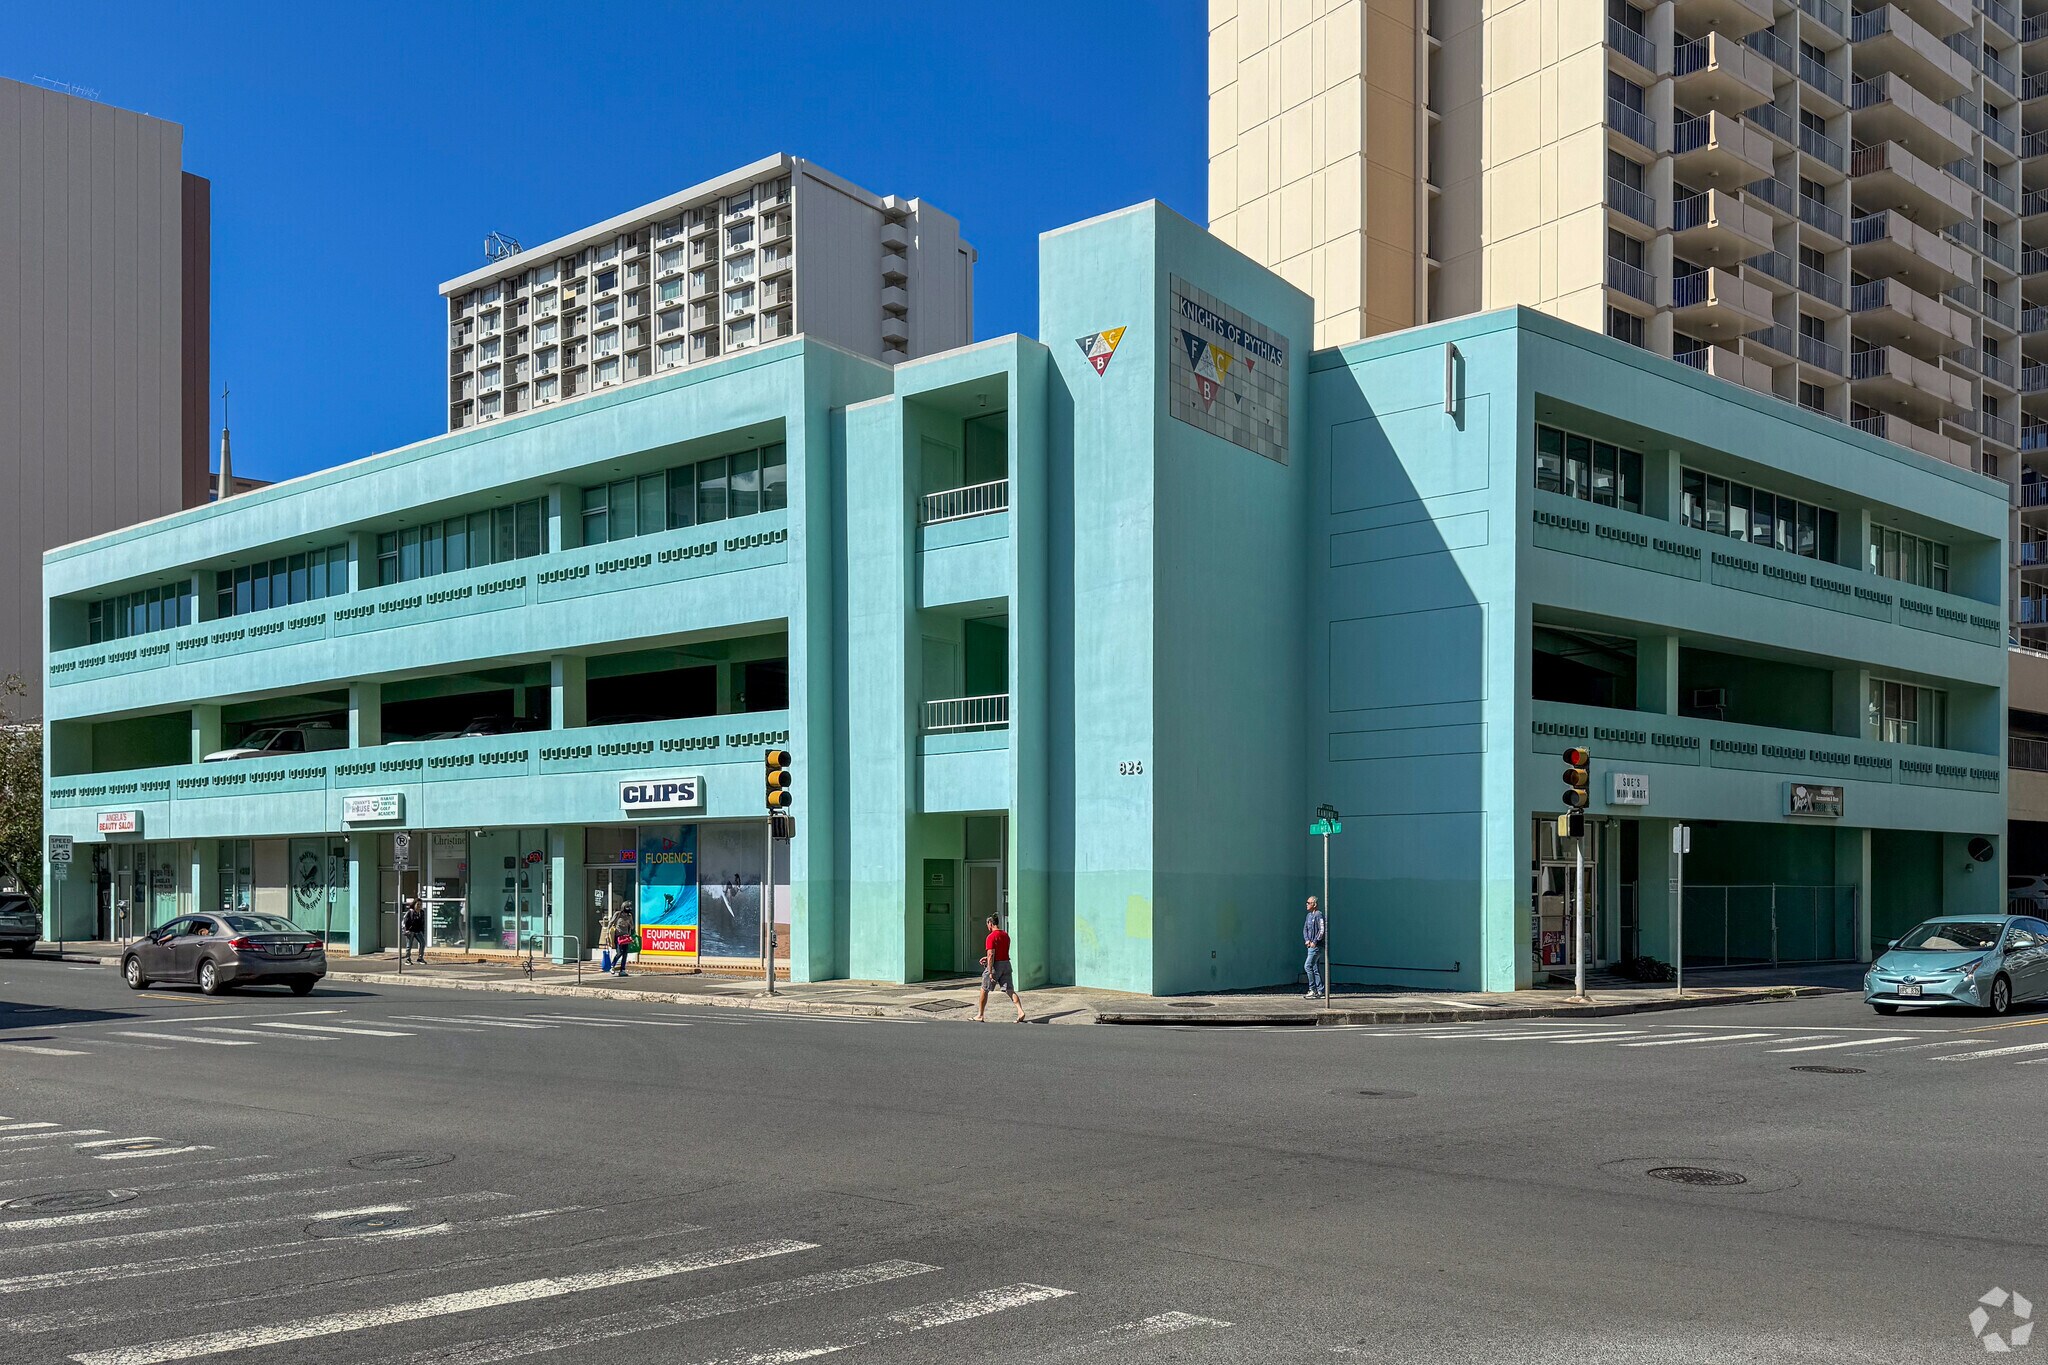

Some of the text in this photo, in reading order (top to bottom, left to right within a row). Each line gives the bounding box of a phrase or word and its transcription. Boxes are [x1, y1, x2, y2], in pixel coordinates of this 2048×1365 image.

[1108, 331, 1116, 344] C
[1180, 296, 1283, 368] KNIGHTS OF PYTHIAS
[1085, 337, 1093, 351] F
[1191, 339, 1199, 359] F
[1096, 356, 1105, 370] B
[1216, 353, 1225, 373] C
[1203, 380, 1211, 401] B
[1119, 760, 1144, 776] 826
[1622, 777, 1641, 788] SUE'S
[622, 782, 695, 804] CLIPS
[106, 813, 127, 822] ANGELA'S
[99, 821, 134, 831] BEAUTY SALON
[433, 834, 466, 846] Christine
[51, 849, 71, 861] 25
[645, 852, 694, 864] FLORENCE
[646, 929, 692, 941] EQUIPMENT
[651, 940, 686, 951] MODERN
